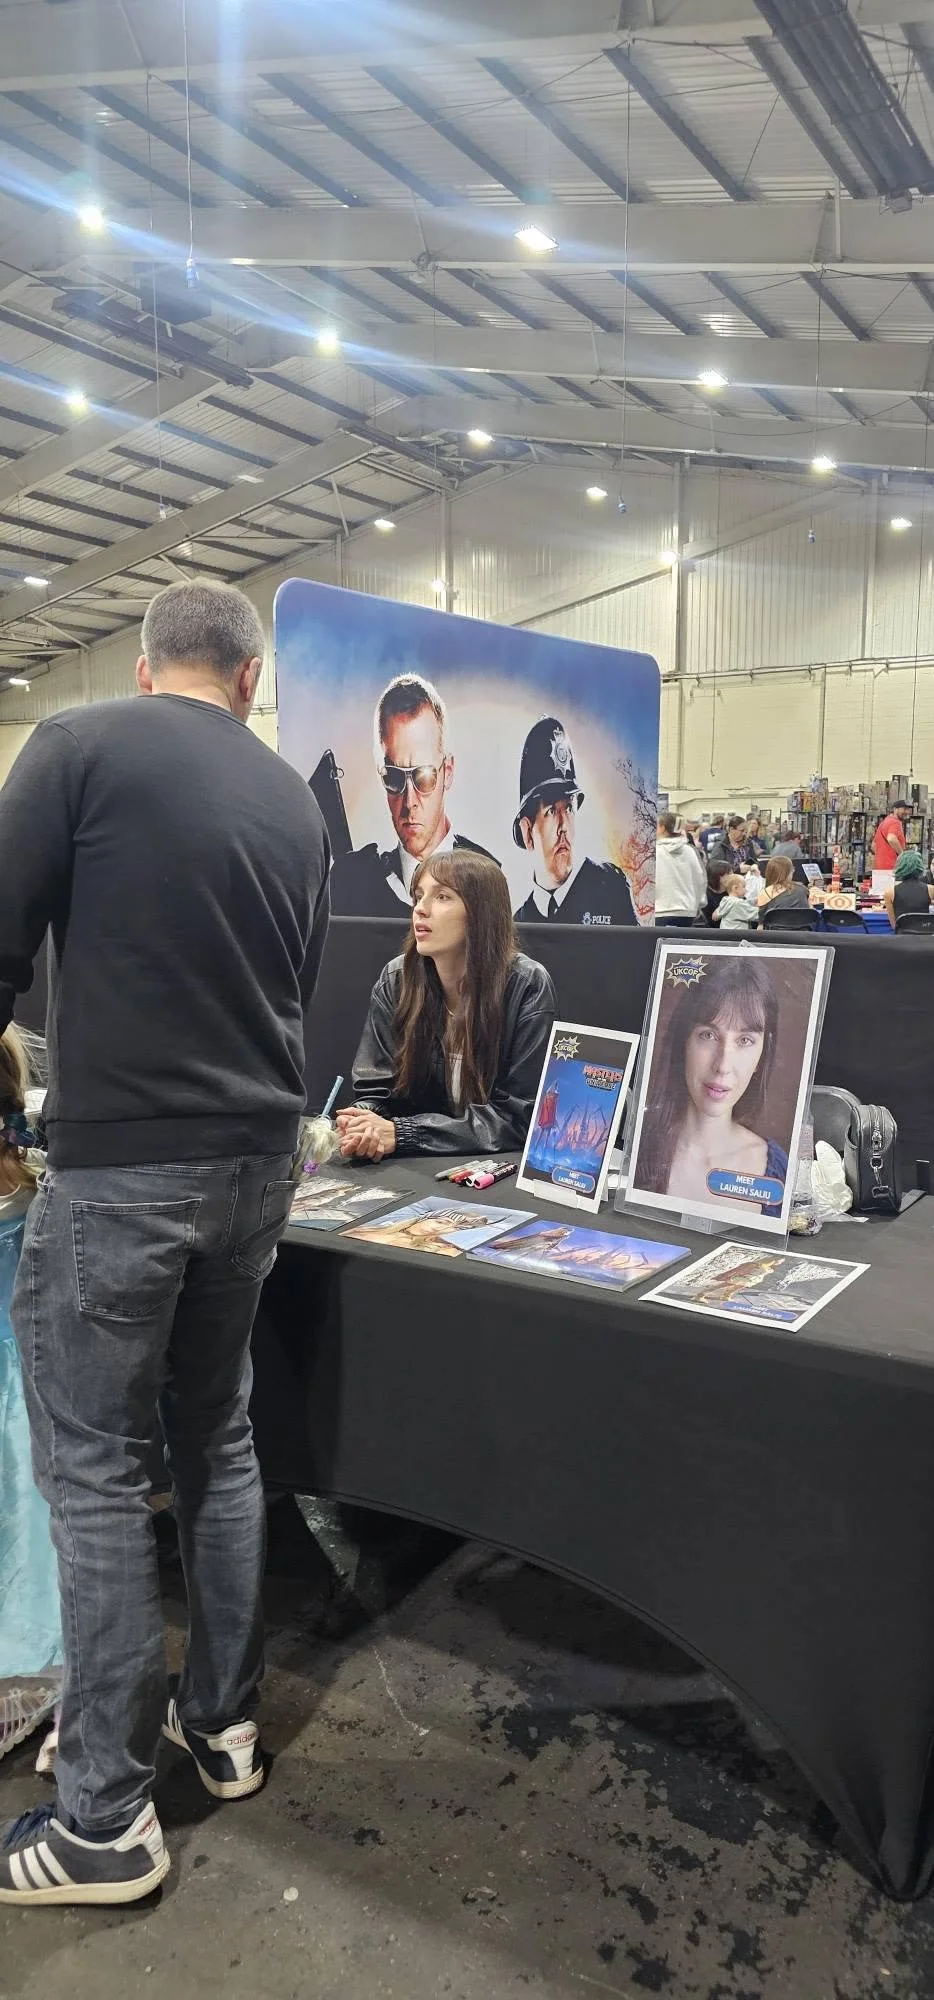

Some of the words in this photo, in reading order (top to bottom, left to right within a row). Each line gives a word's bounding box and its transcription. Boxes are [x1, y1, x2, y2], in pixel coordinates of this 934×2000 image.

[736, 1175, 755, 1185] MEET
[720, 1182, 748, 1195] LAUREN
[749, 1188, 771, 1199] SALIU
